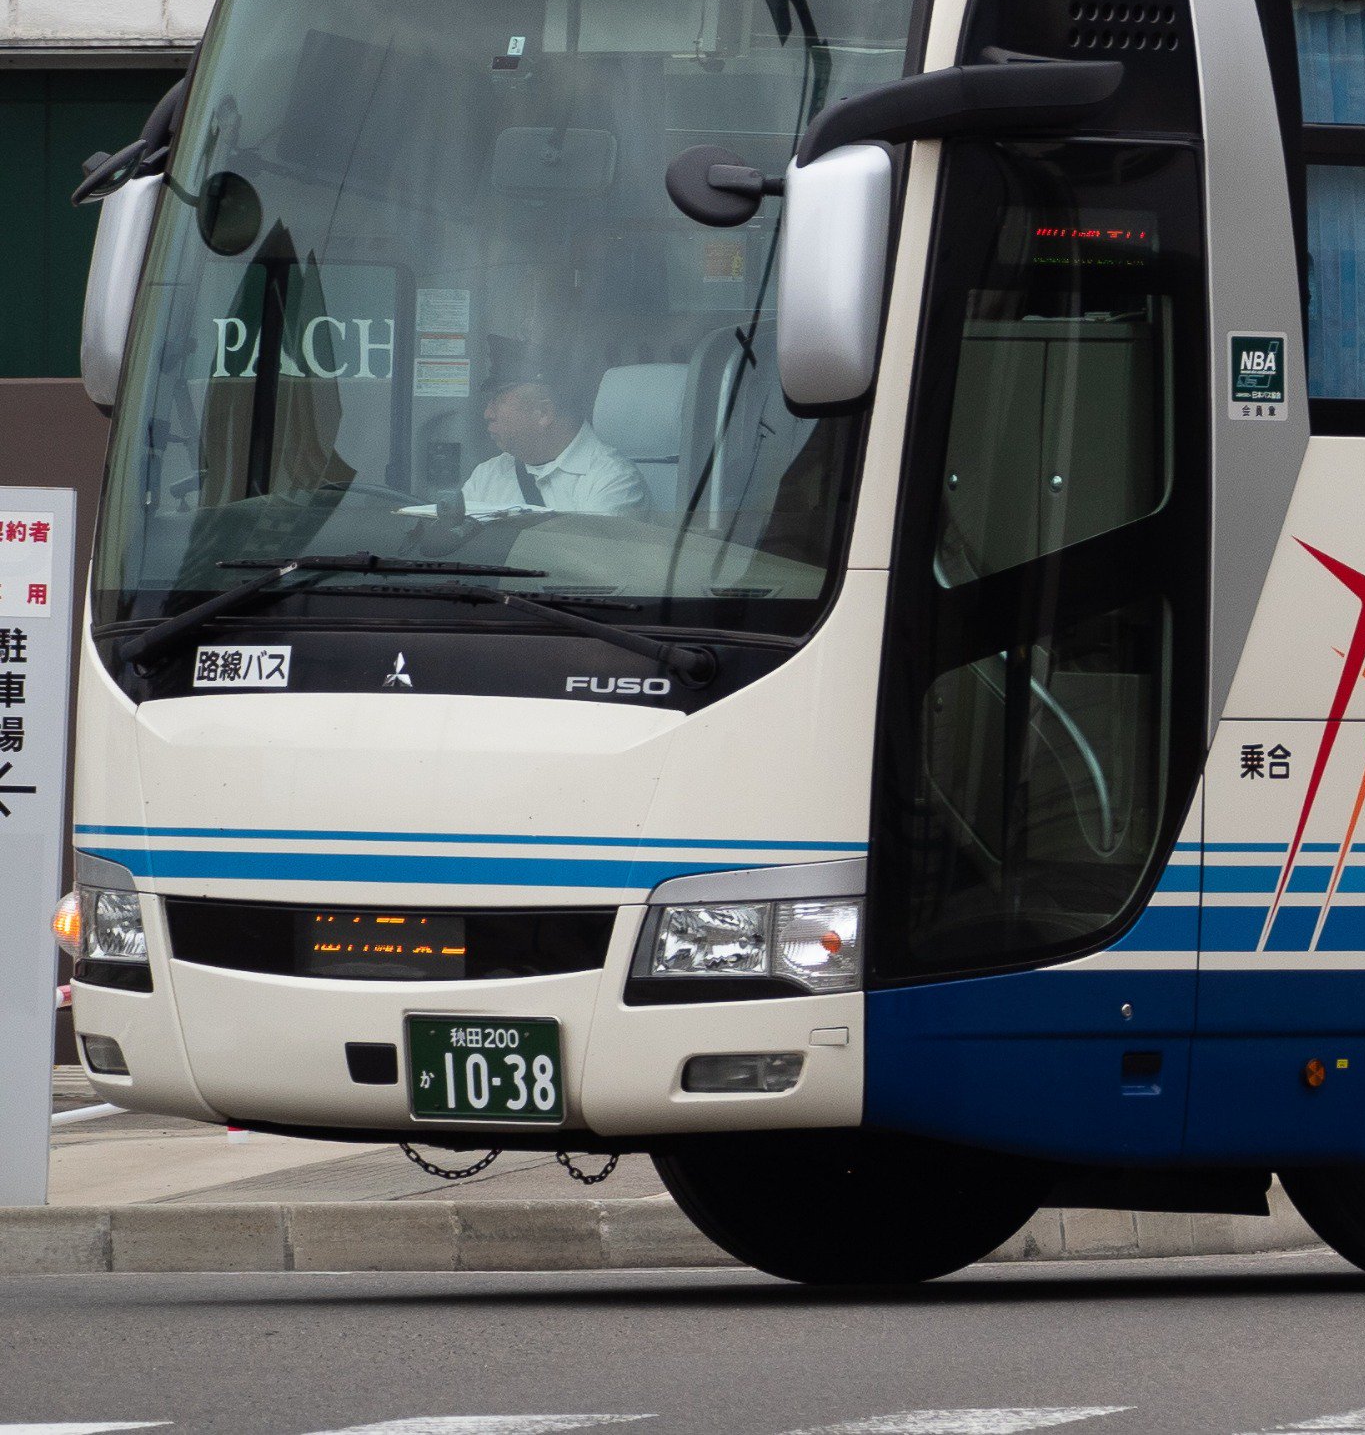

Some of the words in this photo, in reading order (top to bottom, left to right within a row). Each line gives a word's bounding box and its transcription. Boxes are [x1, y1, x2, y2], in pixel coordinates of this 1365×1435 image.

[1240, 351, 1276, 370] NBA
[0, 520, 50, 543] 約者
[196, 650, 285, 682] 路線バス
[565, 676, 671, 695] FUSO
[1240, 743, 1291, 780] 乗合
[419, 1070, 435, 1089] か
[444, 1051, 556, 1111] 10-38
